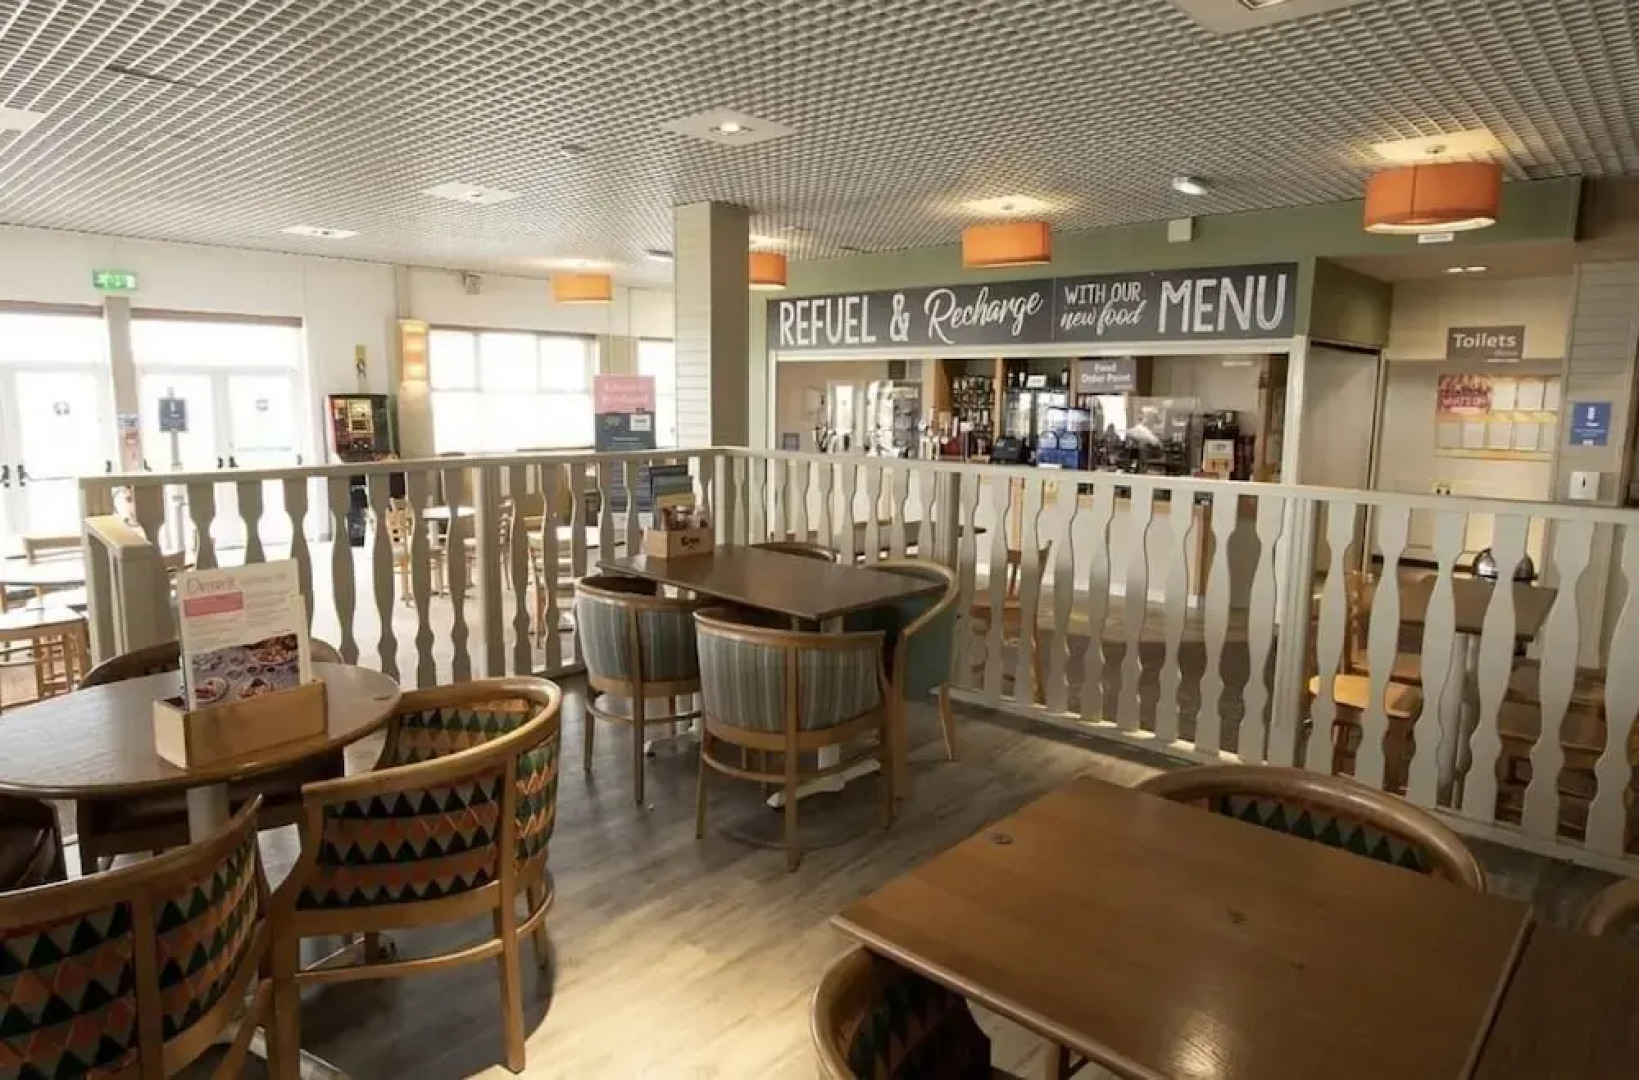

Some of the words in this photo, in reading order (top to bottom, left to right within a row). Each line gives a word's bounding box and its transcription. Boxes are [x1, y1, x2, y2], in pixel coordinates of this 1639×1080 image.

[1064, 285, 1106, 304] WITH
[1111, 282, 1142, 302] OUR
[1158, 274, 1288, 334] MENU
[779, 296, 876, 346] REFUEL
[889, 293, 911, 343] &
[924, 287, 1043, 345] Recharge
[1060, 308, 1096, 330] new
[1096, 300, 1148, 335] food
[1452, 333, 1517, 348] Toilets
